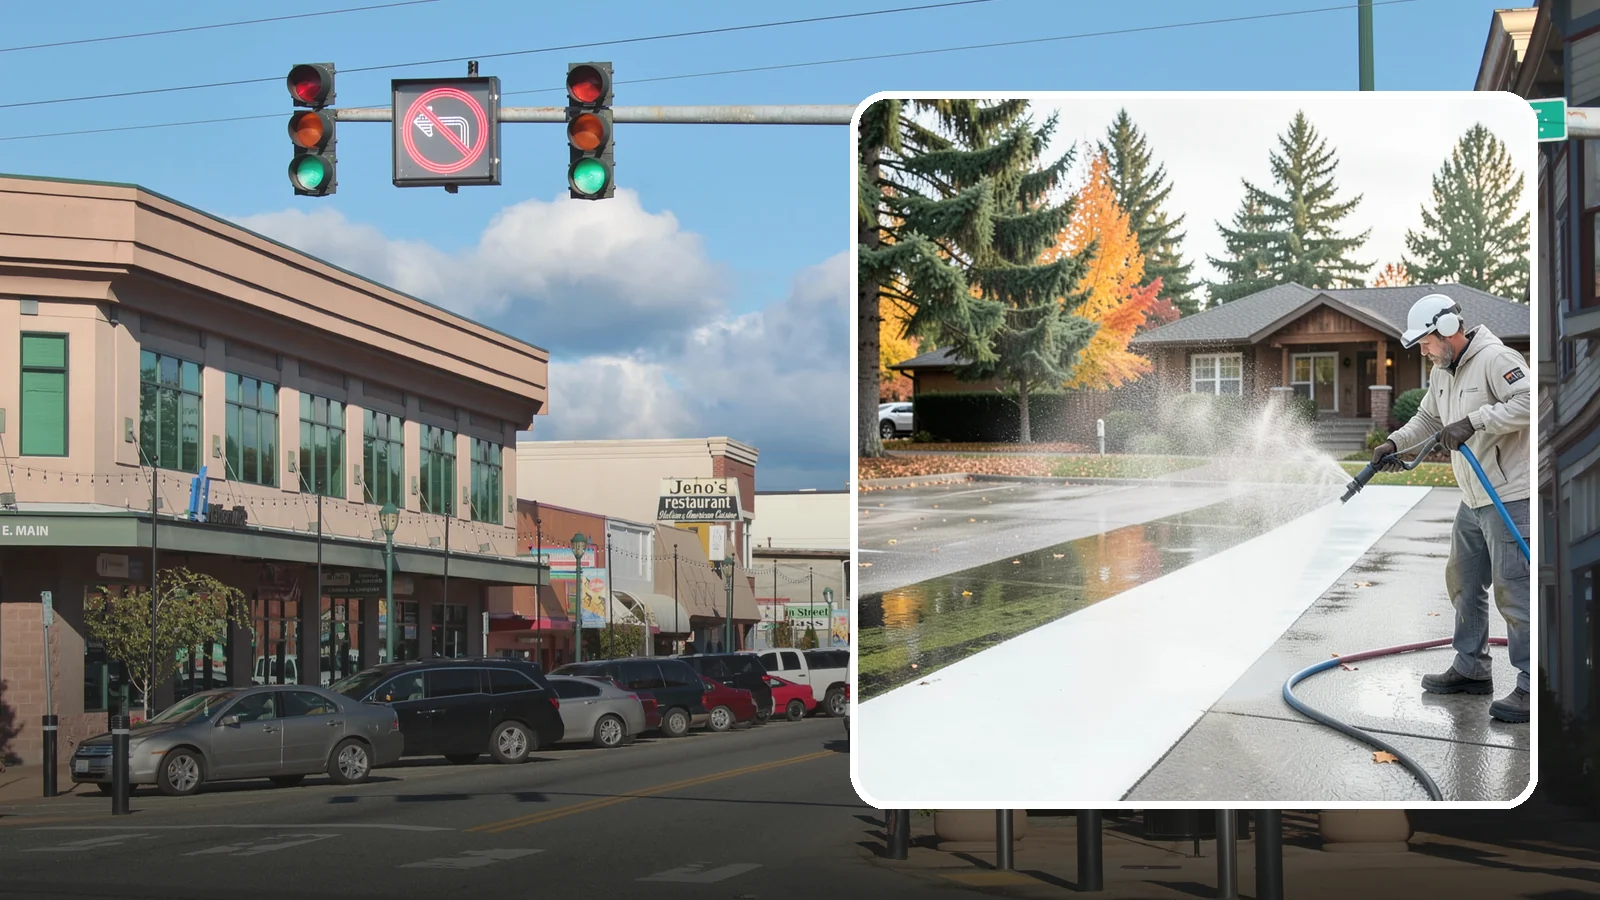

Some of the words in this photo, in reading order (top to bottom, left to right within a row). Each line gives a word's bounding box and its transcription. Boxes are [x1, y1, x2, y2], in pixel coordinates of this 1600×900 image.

[670, 480, 727, 494] Jeno's
[665, 496, 731, 509] restaurant
[658, 509, 681, 519] Italian
[686, 509, 714, 519] American
[715, 509, 737, 519] Cuisine
[2, 525, 13, 536] E.
[15, 525, 49, 536] MAIN
[797, 607, 828, 616] Street
